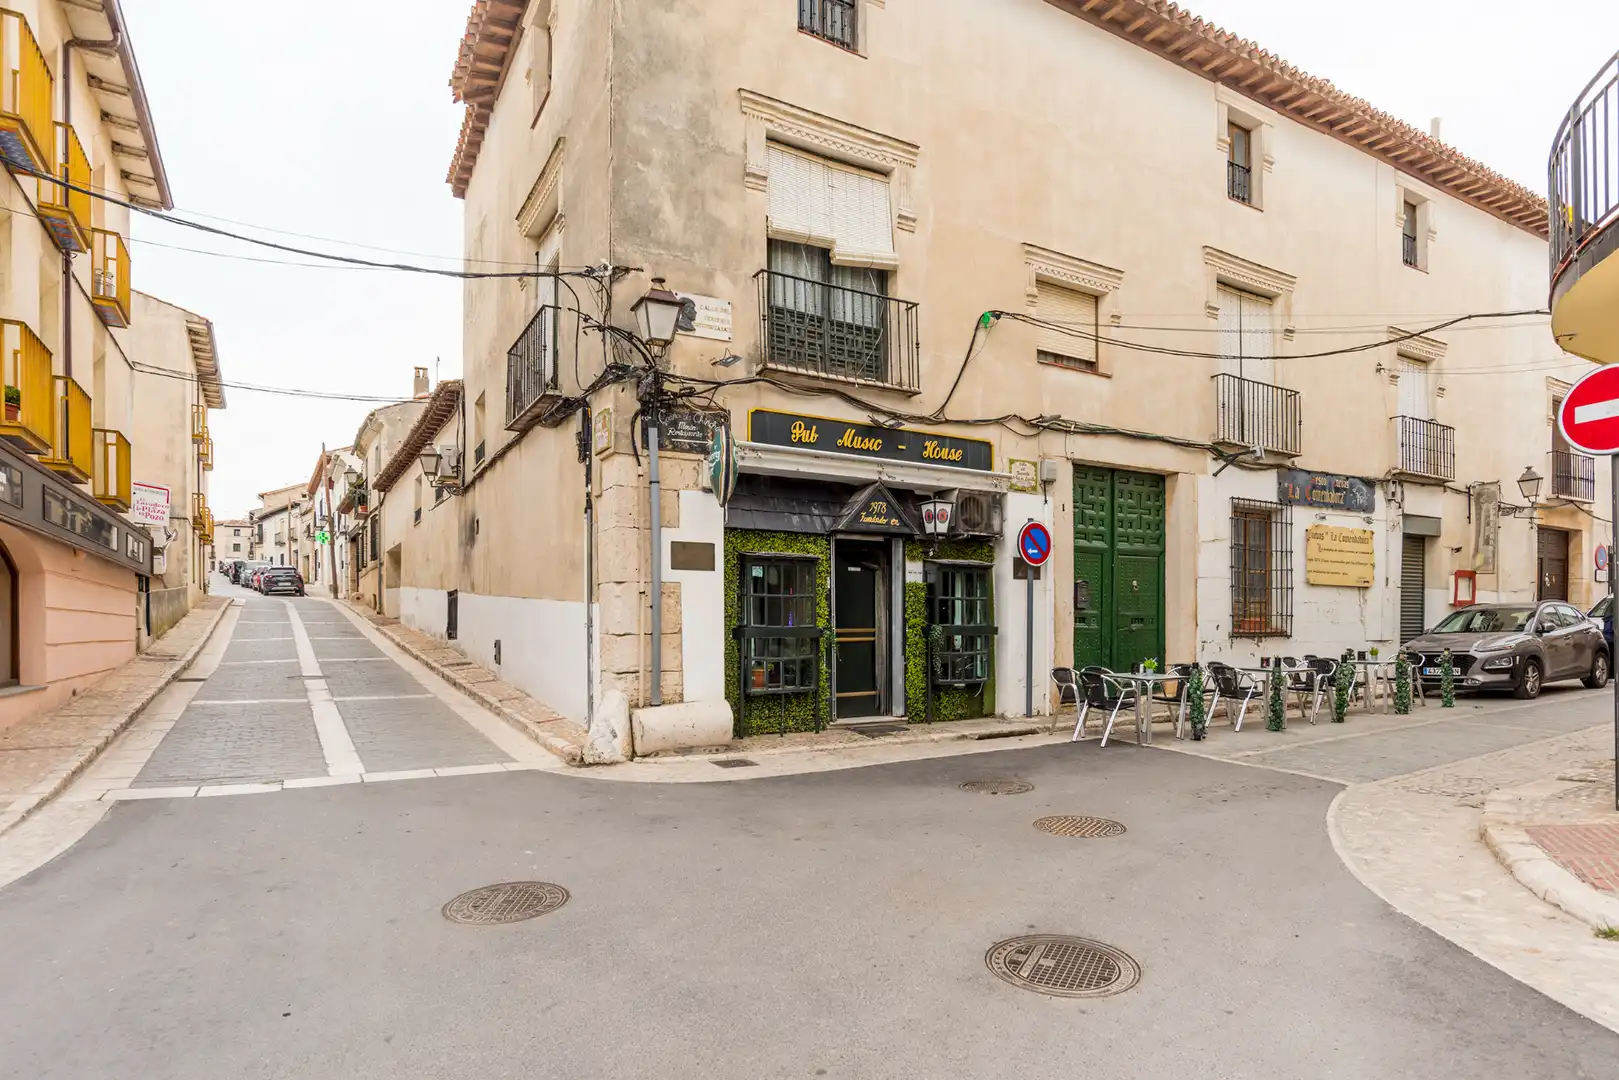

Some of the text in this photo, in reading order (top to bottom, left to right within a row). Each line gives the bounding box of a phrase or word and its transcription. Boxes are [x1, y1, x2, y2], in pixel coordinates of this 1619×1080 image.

[693, 411, 720, 432] Chincho
[791, 420, 819, 443] Pub
[836, 428, 883, 451] Music
[922, 440, 963, 462] House
[142, 506, 165, 515] Plaza
[869, 501, 887, 514] 1978
[145, 512, 164, 521] Pozo
[859, 511, 889, 525] Fundado
